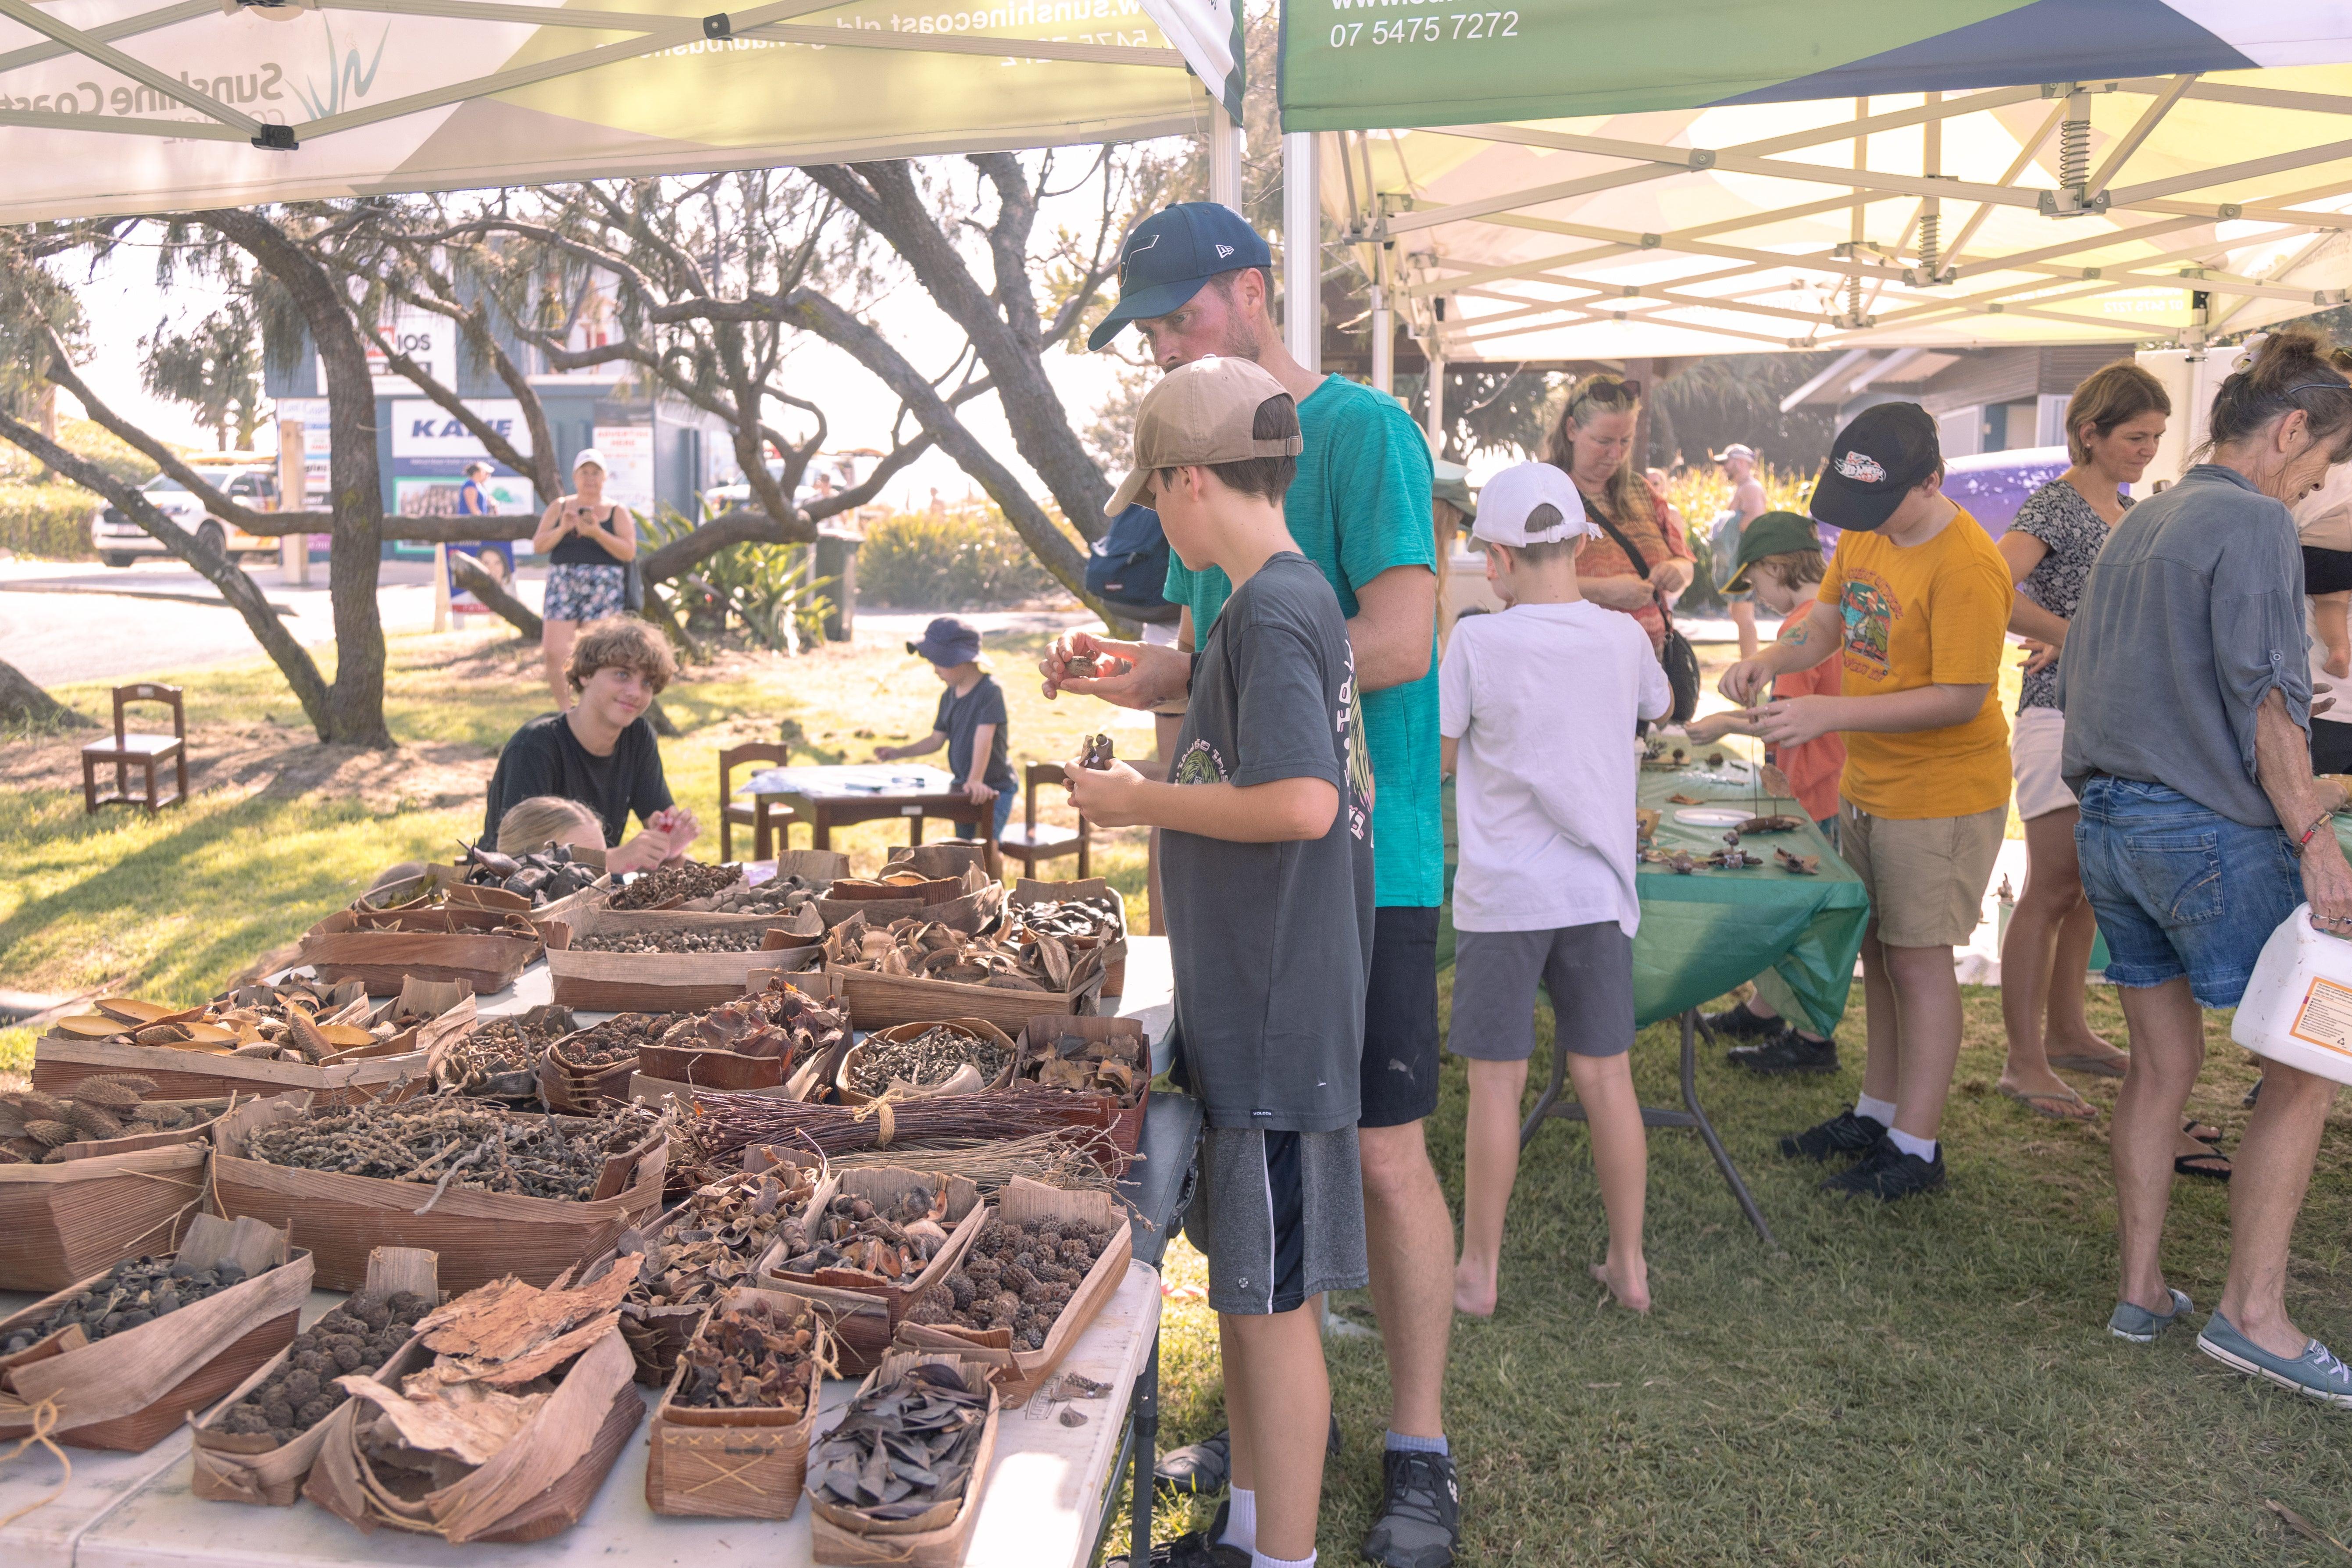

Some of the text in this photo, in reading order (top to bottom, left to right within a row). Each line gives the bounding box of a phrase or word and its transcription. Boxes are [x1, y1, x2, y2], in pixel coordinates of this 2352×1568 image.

[1330, 11, 1518, 48] 07 5475 7272
[412, 420, 512, 438] KAE
